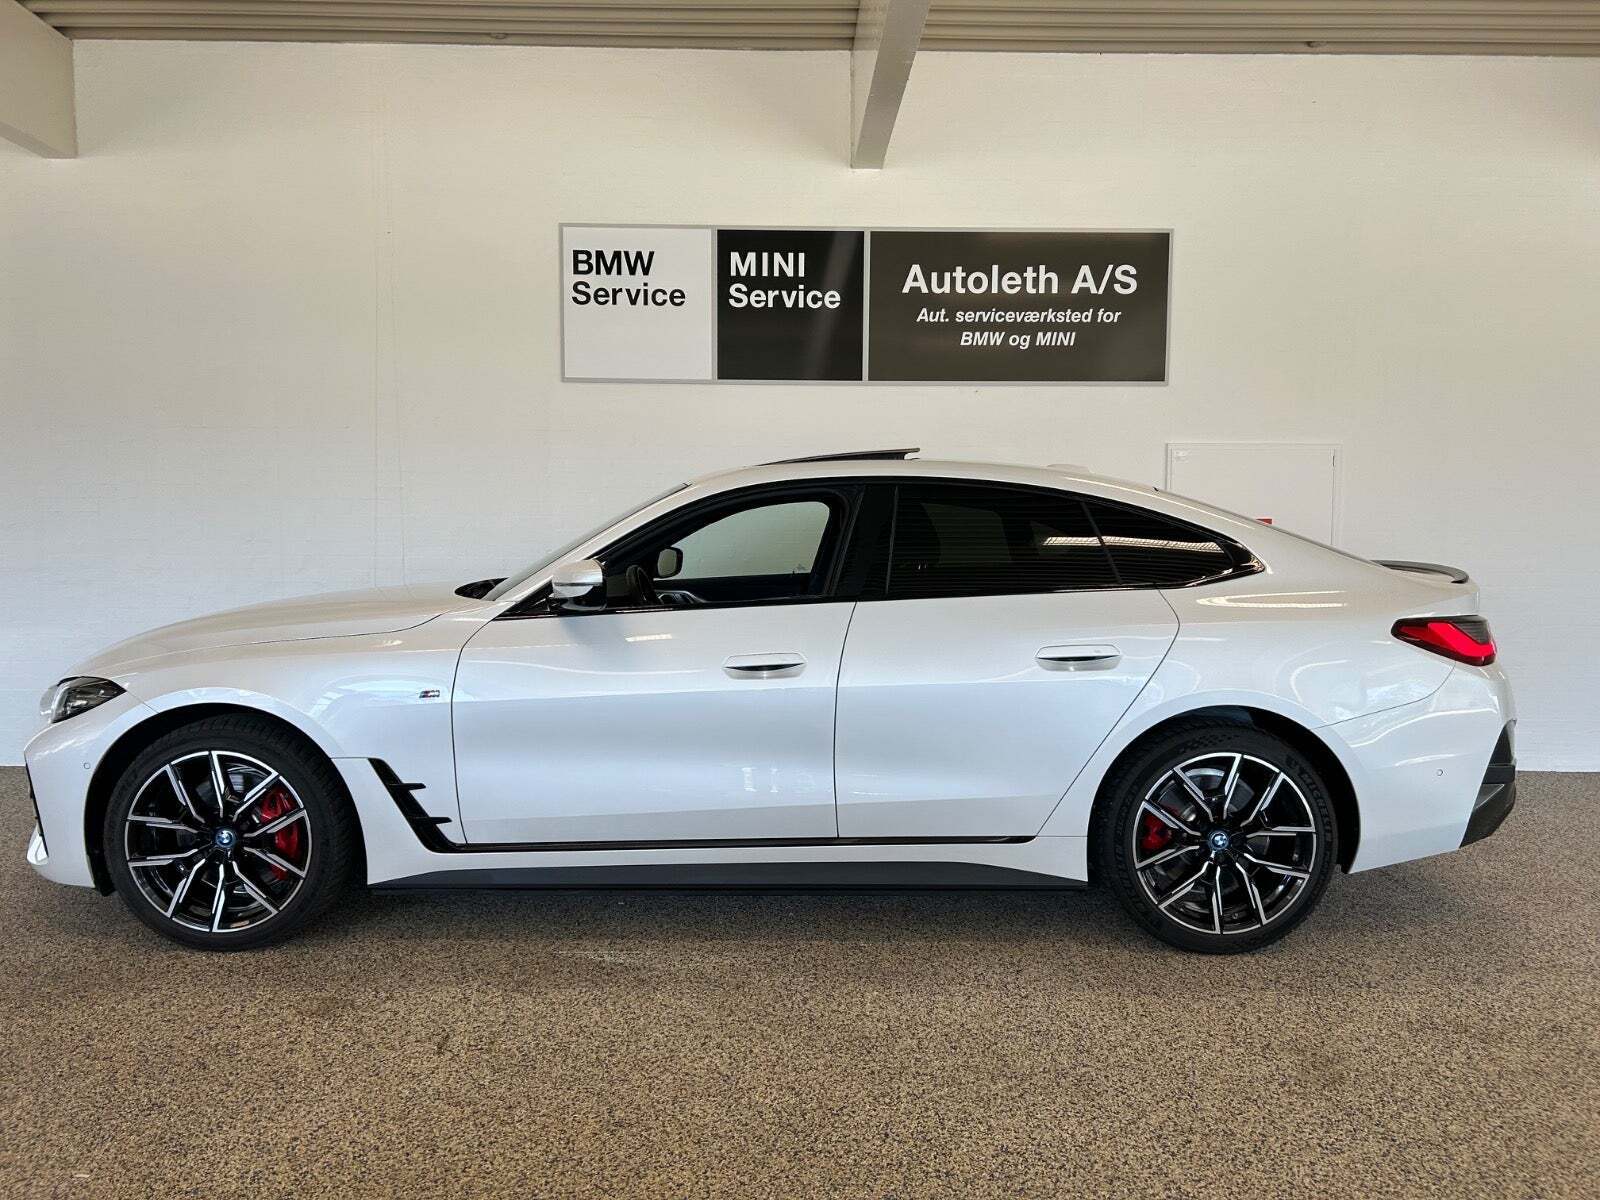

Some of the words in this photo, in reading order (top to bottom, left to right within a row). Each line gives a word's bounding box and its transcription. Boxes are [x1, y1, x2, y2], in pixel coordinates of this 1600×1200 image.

[572, 249, 655, 277] BMW
[730, 251, 805, 278] MINI
[901, 263, 1059, 295] Autoleth
[1070, 264, 1138, 295] A/S
[571, 280, 686, 307] Service
[728, 282, 841, 309] Service
[915, 307, 950, 323] Aut.
[955, 307, 1093, 323] serviceværksted
[1096, 307, 1122, 323] for
[959, 331, 1006, 346] BMW
[1008, 334, 1031, 350] og
[1035, 331, 1076, 346] MINI
